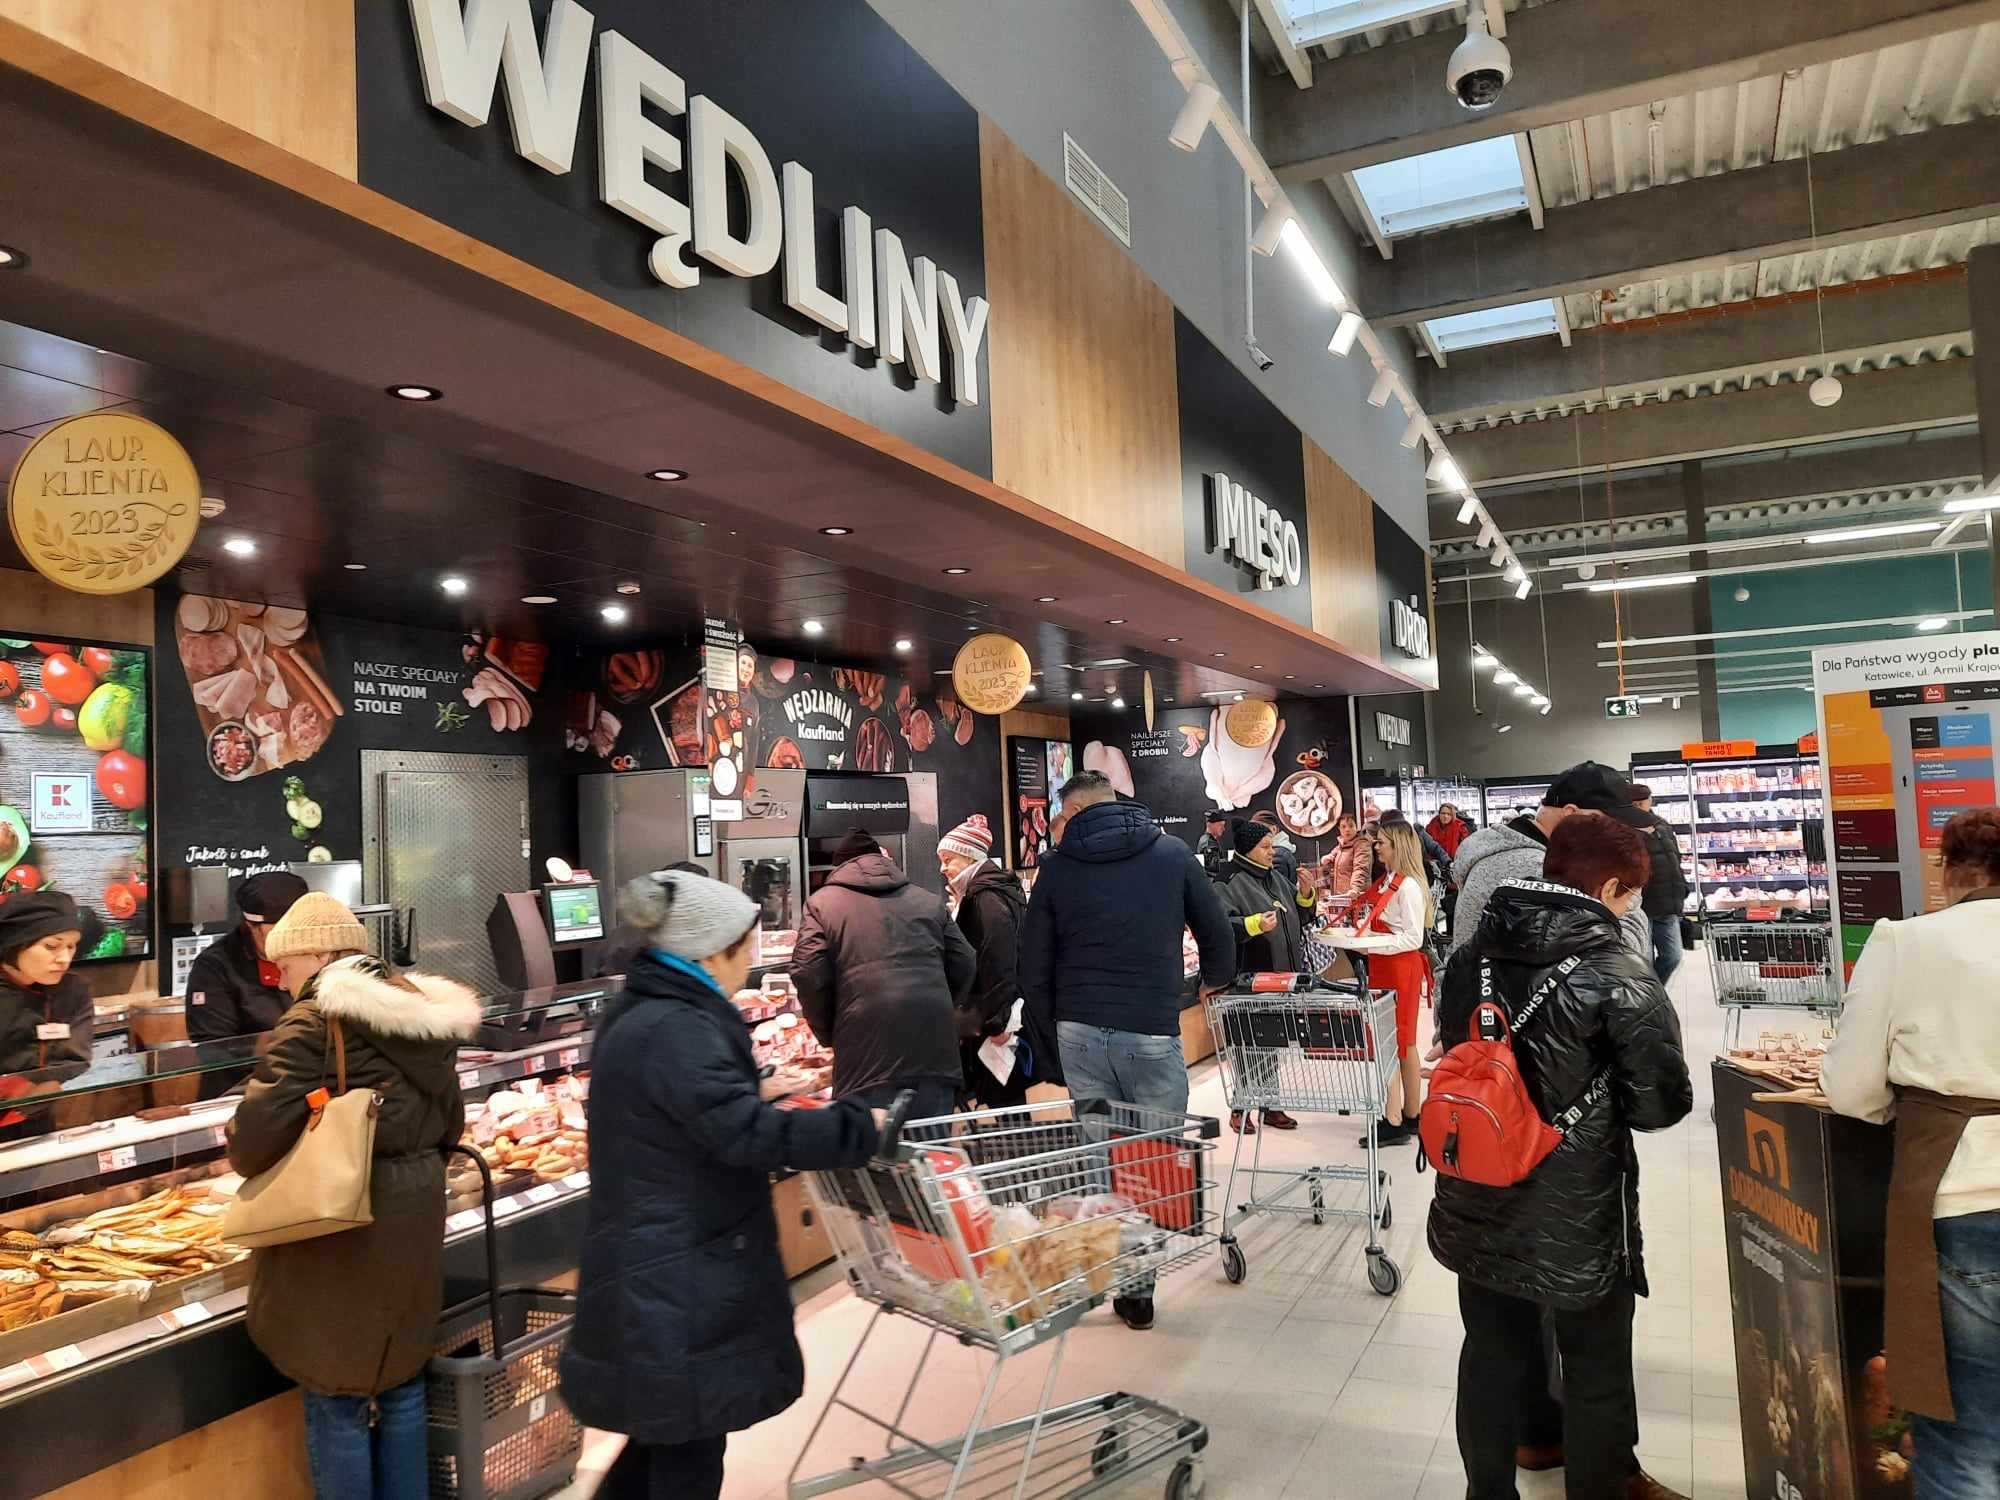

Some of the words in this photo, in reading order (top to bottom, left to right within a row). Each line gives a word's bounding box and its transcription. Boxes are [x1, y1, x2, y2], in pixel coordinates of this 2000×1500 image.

[407, 0, 990, 406] WĘDLINY
[63, 435, 146, 464] LAUR
[41, 468, 168, 497] KLIENTA
[70, 508, 139, 536] 2023
[1213, 472, 1301, 592] MIĘSO
[1393, 594, 1430, 660] DRÓB
[353, 661, 399, 678] NASZE
[964, 657, 1016, 675] KLIENTA
[1822, 660, 1842, 672] Dla
[1845, 655, 1902, 669] Państwa
[1906, 645, 1967, 664] wygody
[353, 681, 375, 695] NA
[378, 683, 427, 699] TWOIM
[1865, 670, 1914, 682] Katowice,
[783, 689, 853, 730] WĘDZARNIA
[797, 722, 845, 742] Kaufland
[1130, 729, 1172, 740] NAJLEPSZE
[1376, 711, 1410, 750] WĘDLINY
[1138, 747, 1169, 757] DROBIU
[185, 846, 228, 863] Jakość
[230, 848, 237, 859] i
[240, 845, 270, 859] smak
[1481, 967, 1492, 996] BAG
[1510, 977, 1558, 1032] FASHION
